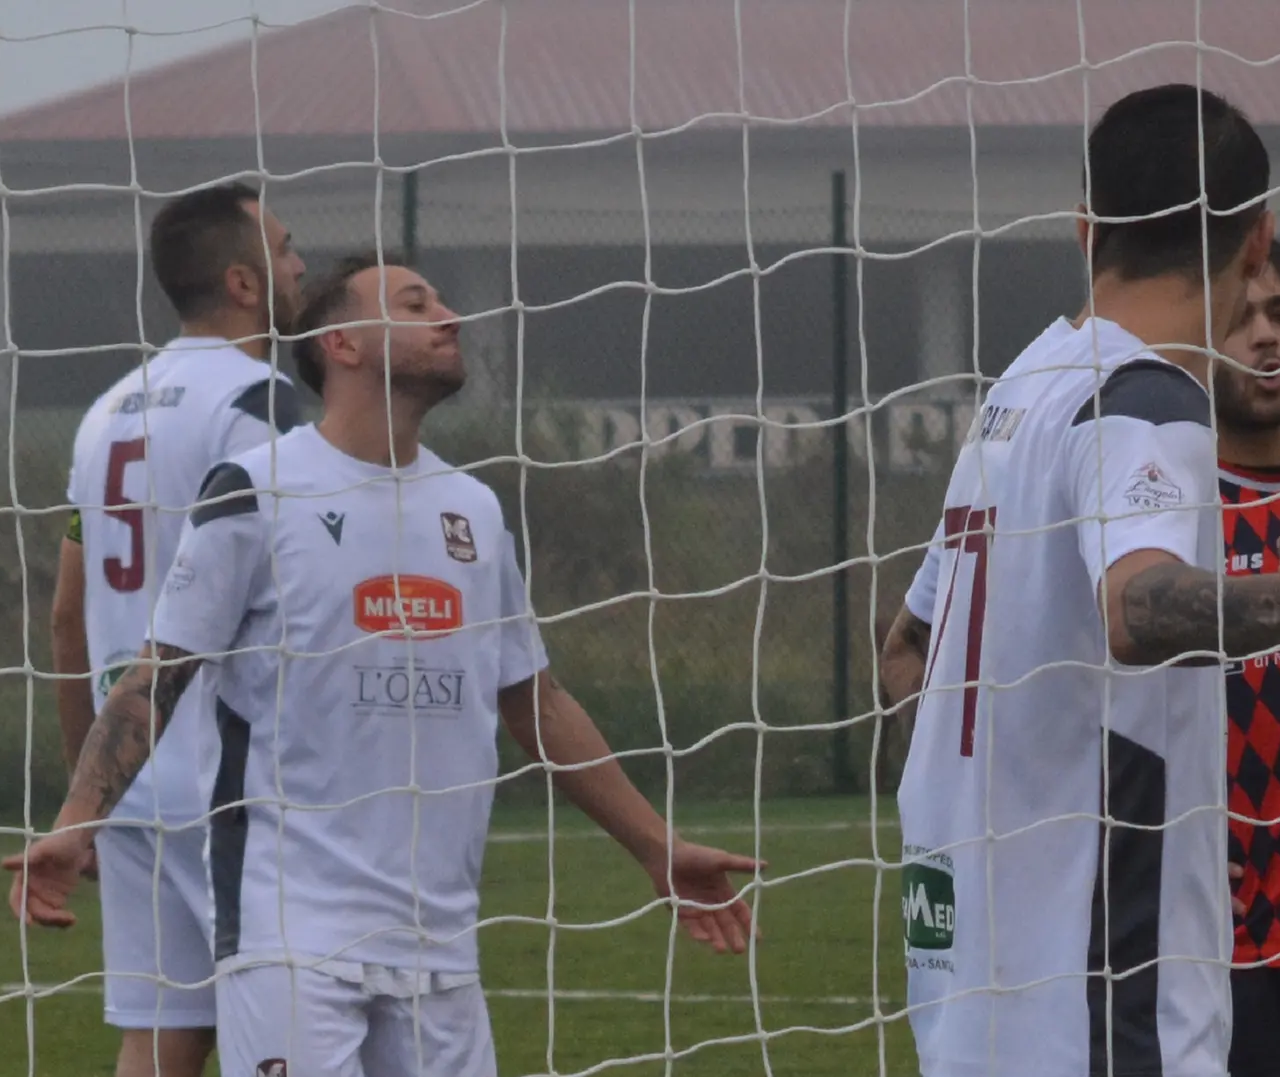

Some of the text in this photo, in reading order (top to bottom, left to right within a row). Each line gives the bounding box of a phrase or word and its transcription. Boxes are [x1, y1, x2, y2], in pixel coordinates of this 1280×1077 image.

[102, 435, 150, 593] 5
[363, 596, 452, 619] MICELI
[356, 670, 466, 706] L'OASI
